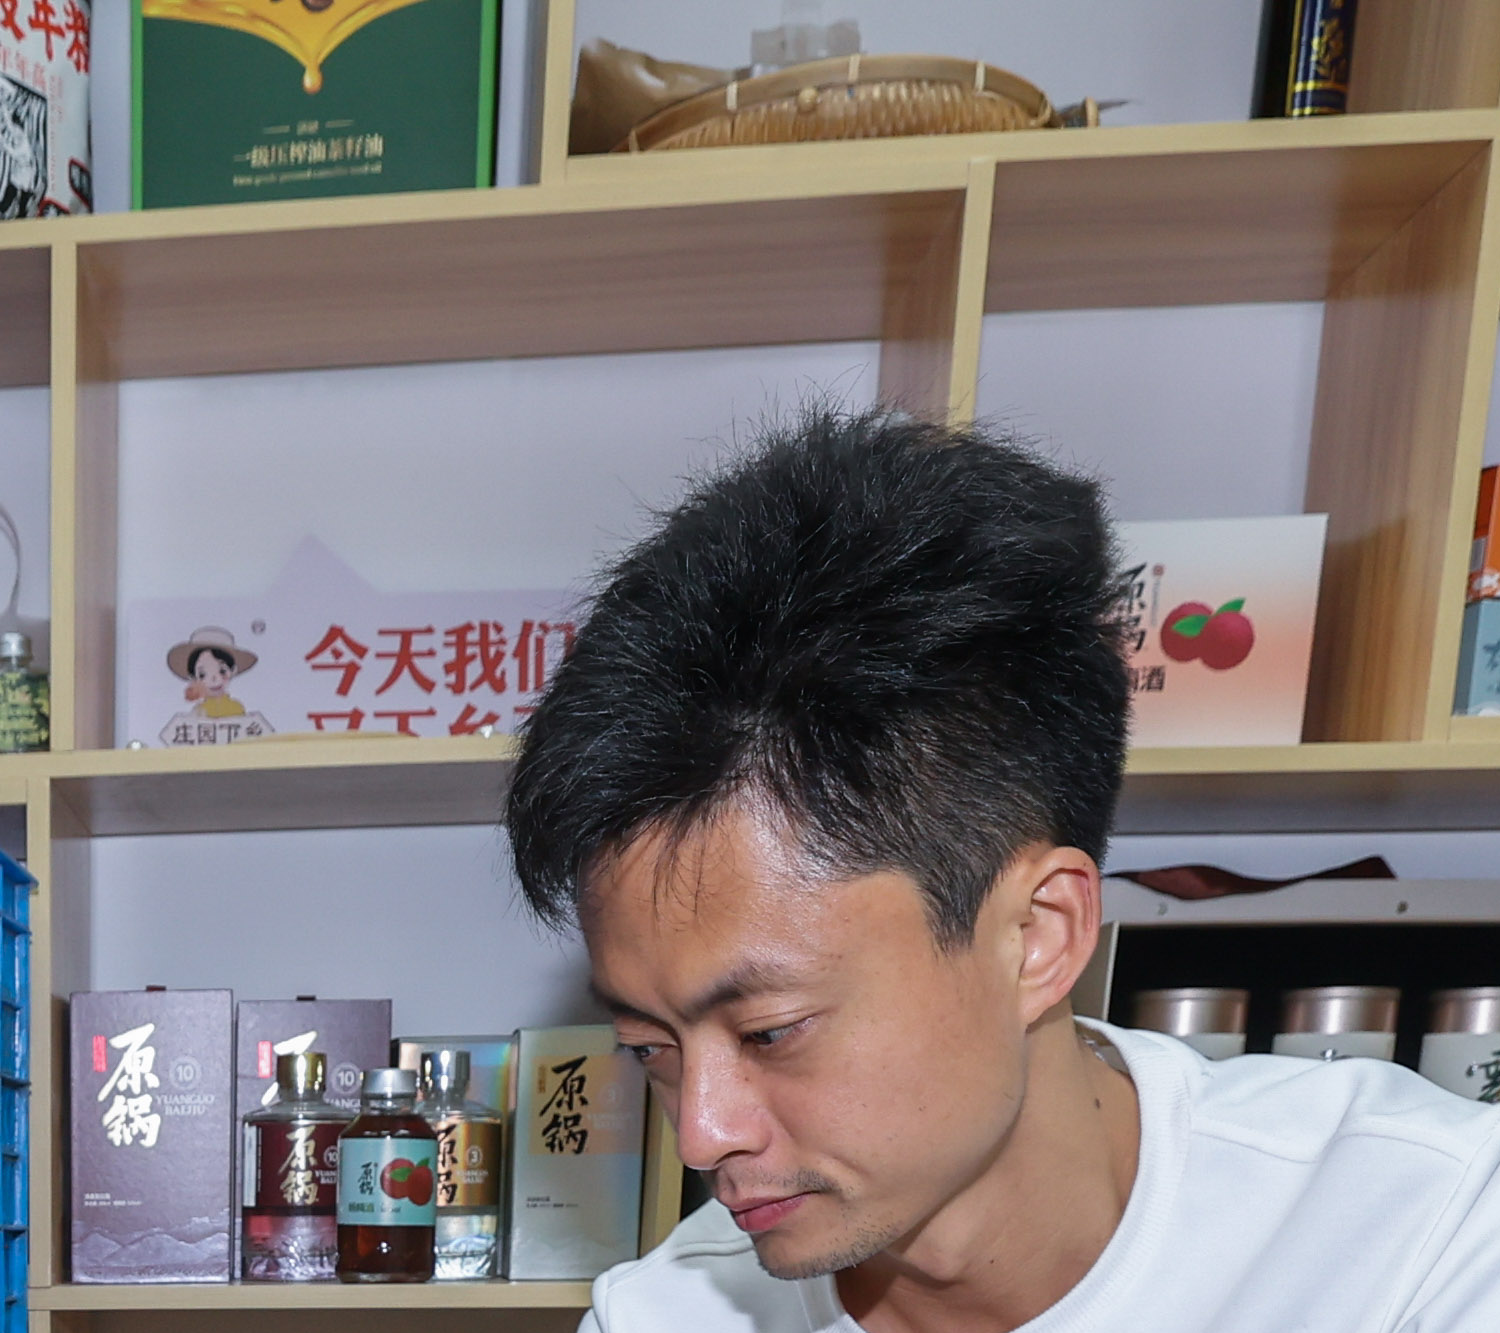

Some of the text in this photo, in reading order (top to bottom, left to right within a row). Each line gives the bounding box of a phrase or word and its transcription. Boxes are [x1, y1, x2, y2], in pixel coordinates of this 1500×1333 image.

[98, 1023, 161, 1147] 原锅
[539, 1055, 588, 1154] 原锅
[278, 1125, 320, 1205] 原锅
